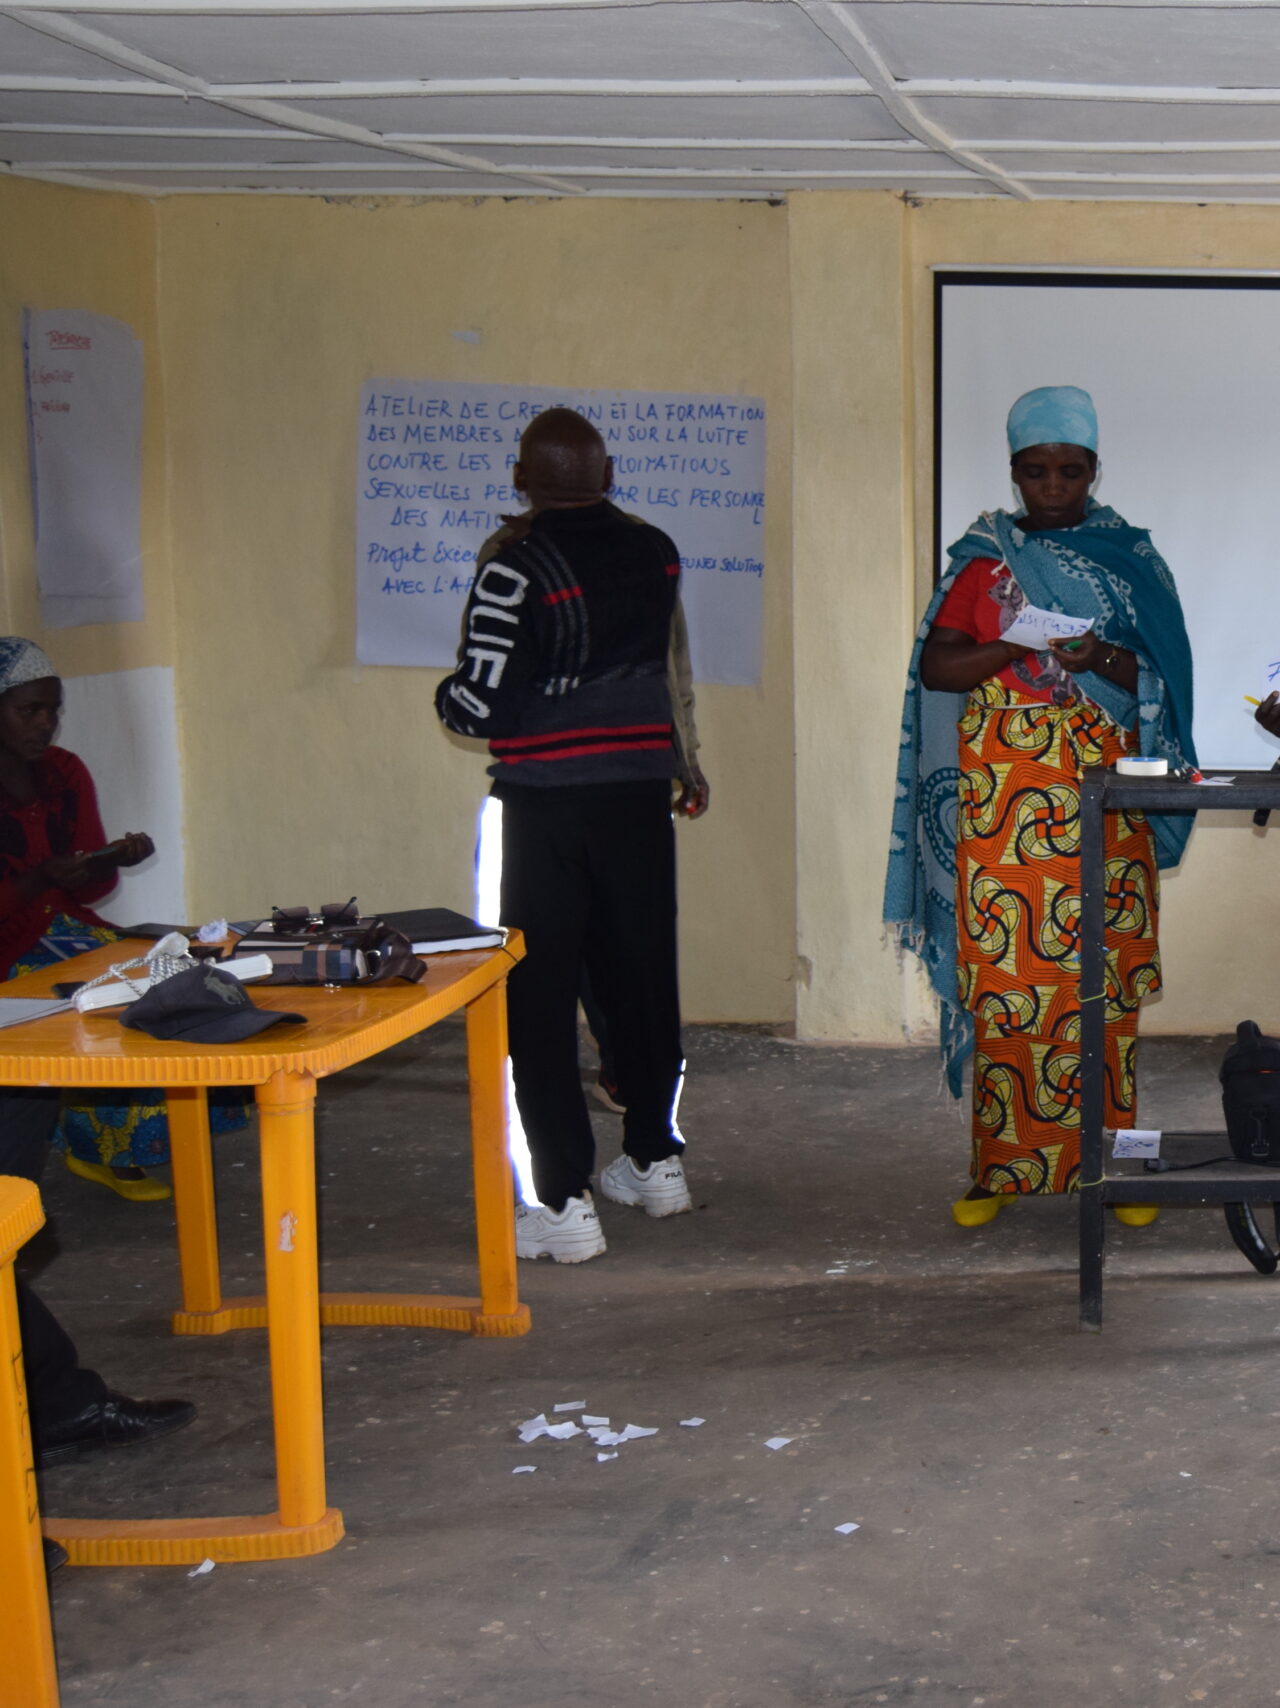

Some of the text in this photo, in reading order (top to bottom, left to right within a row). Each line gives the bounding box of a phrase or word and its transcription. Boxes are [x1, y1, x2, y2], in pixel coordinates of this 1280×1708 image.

[365, 394, 454, 419] ATELIER
[459, 401, 489, 420] DE
[636, 403, 658, 421] LA
[665, 403, 765, 422] FORMATION
[367, 424, 397, 441] DES
[403, 424, 504, 444] MEMBRES
[627, 426, 660, 443] SUR
[665, 427, 689, 442] LA
[698, 427, 749, 446] LUTTE
[366, 452, 449, 472] CONTRE
[459, 453, 493, 472] LES
[364, 478, 471, 501] SEXUELLES
[647, 487, 681, 507] LES
[390, 506, 428, 527] DES
